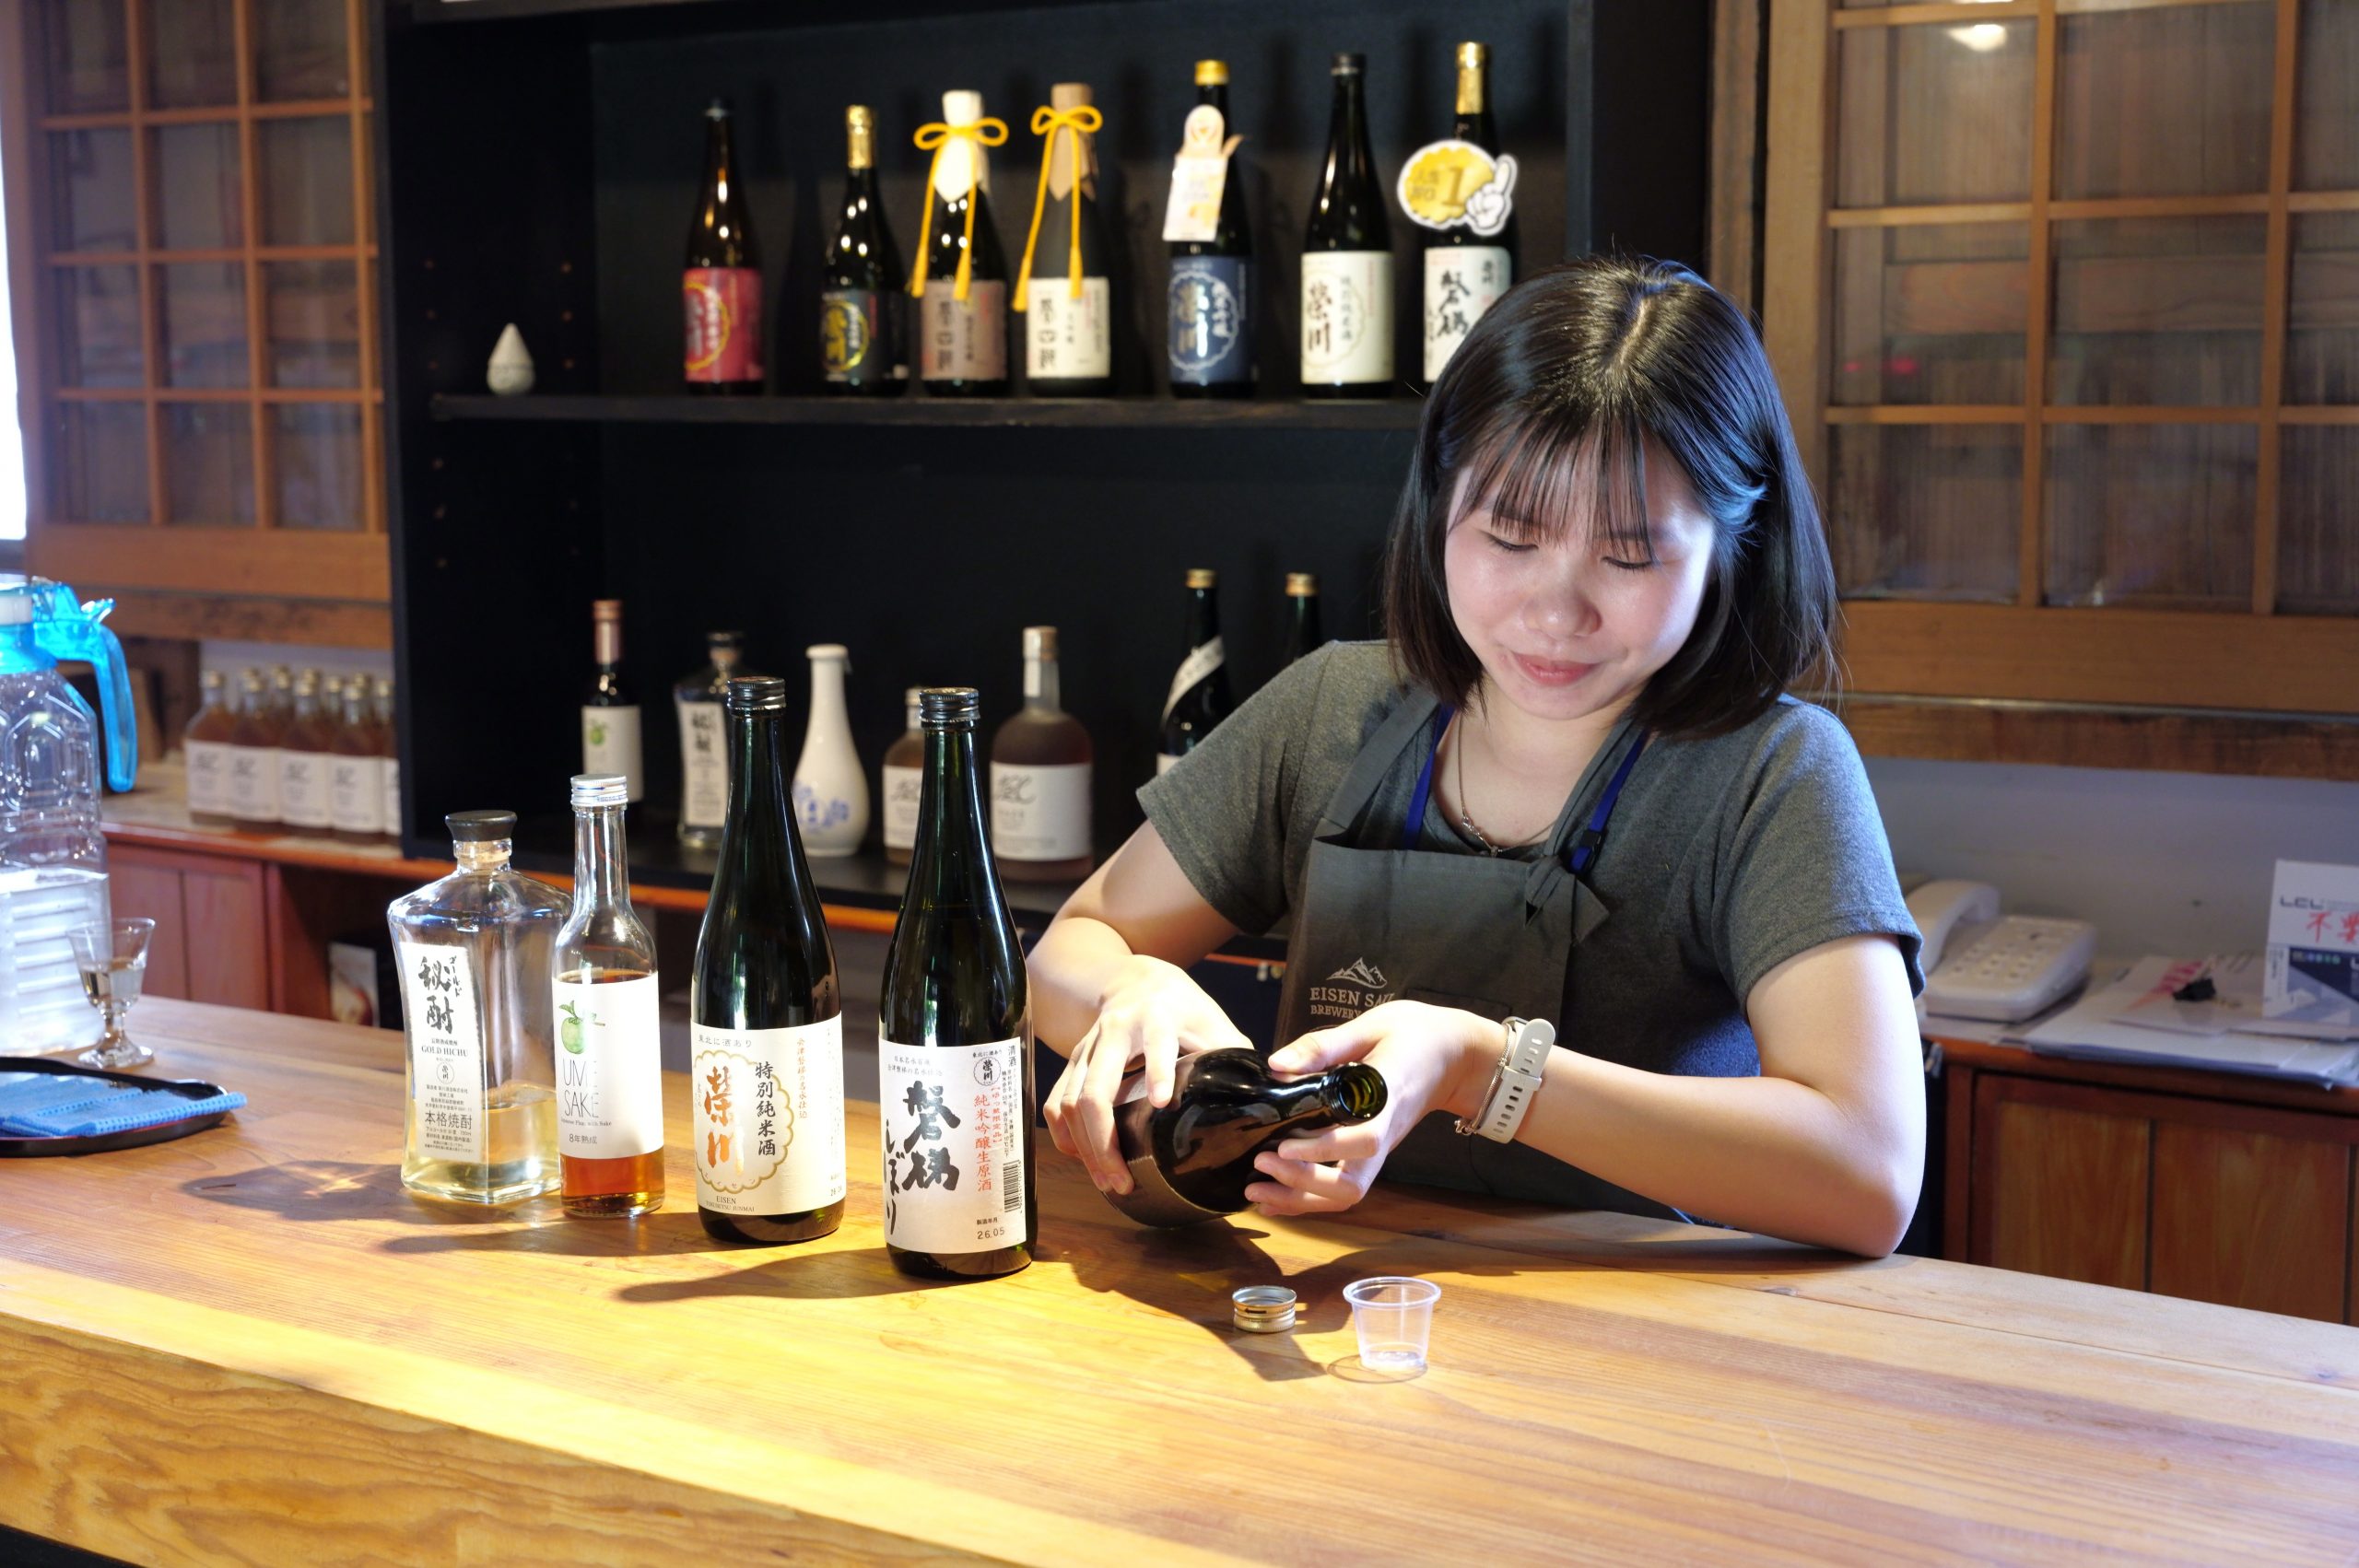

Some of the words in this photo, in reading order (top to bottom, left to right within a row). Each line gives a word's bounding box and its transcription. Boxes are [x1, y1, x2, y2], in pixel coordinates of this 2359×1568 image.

[1309, 987, 1361, 1007] EISEN
[1310, 1004, 1363, 1019] BREWERY
[698, 1035, 753, 1047] 東北に酒あり
[421, 1045, 442, 1055] GOLD
[443, 1047, 469, 1058] HICHU
[1008, 1045, 1016, 1067] 清酒
[564, 1089, 599, 1118] SAKE
[755, 1061, 776, 1156] 特別純米酒
[425, 1110, 472, 1129] 本格焼酎
[974, 1094, 992, 1191] 純米吟醸生原酒
[716, 1195, 736, 1204] EISEN
